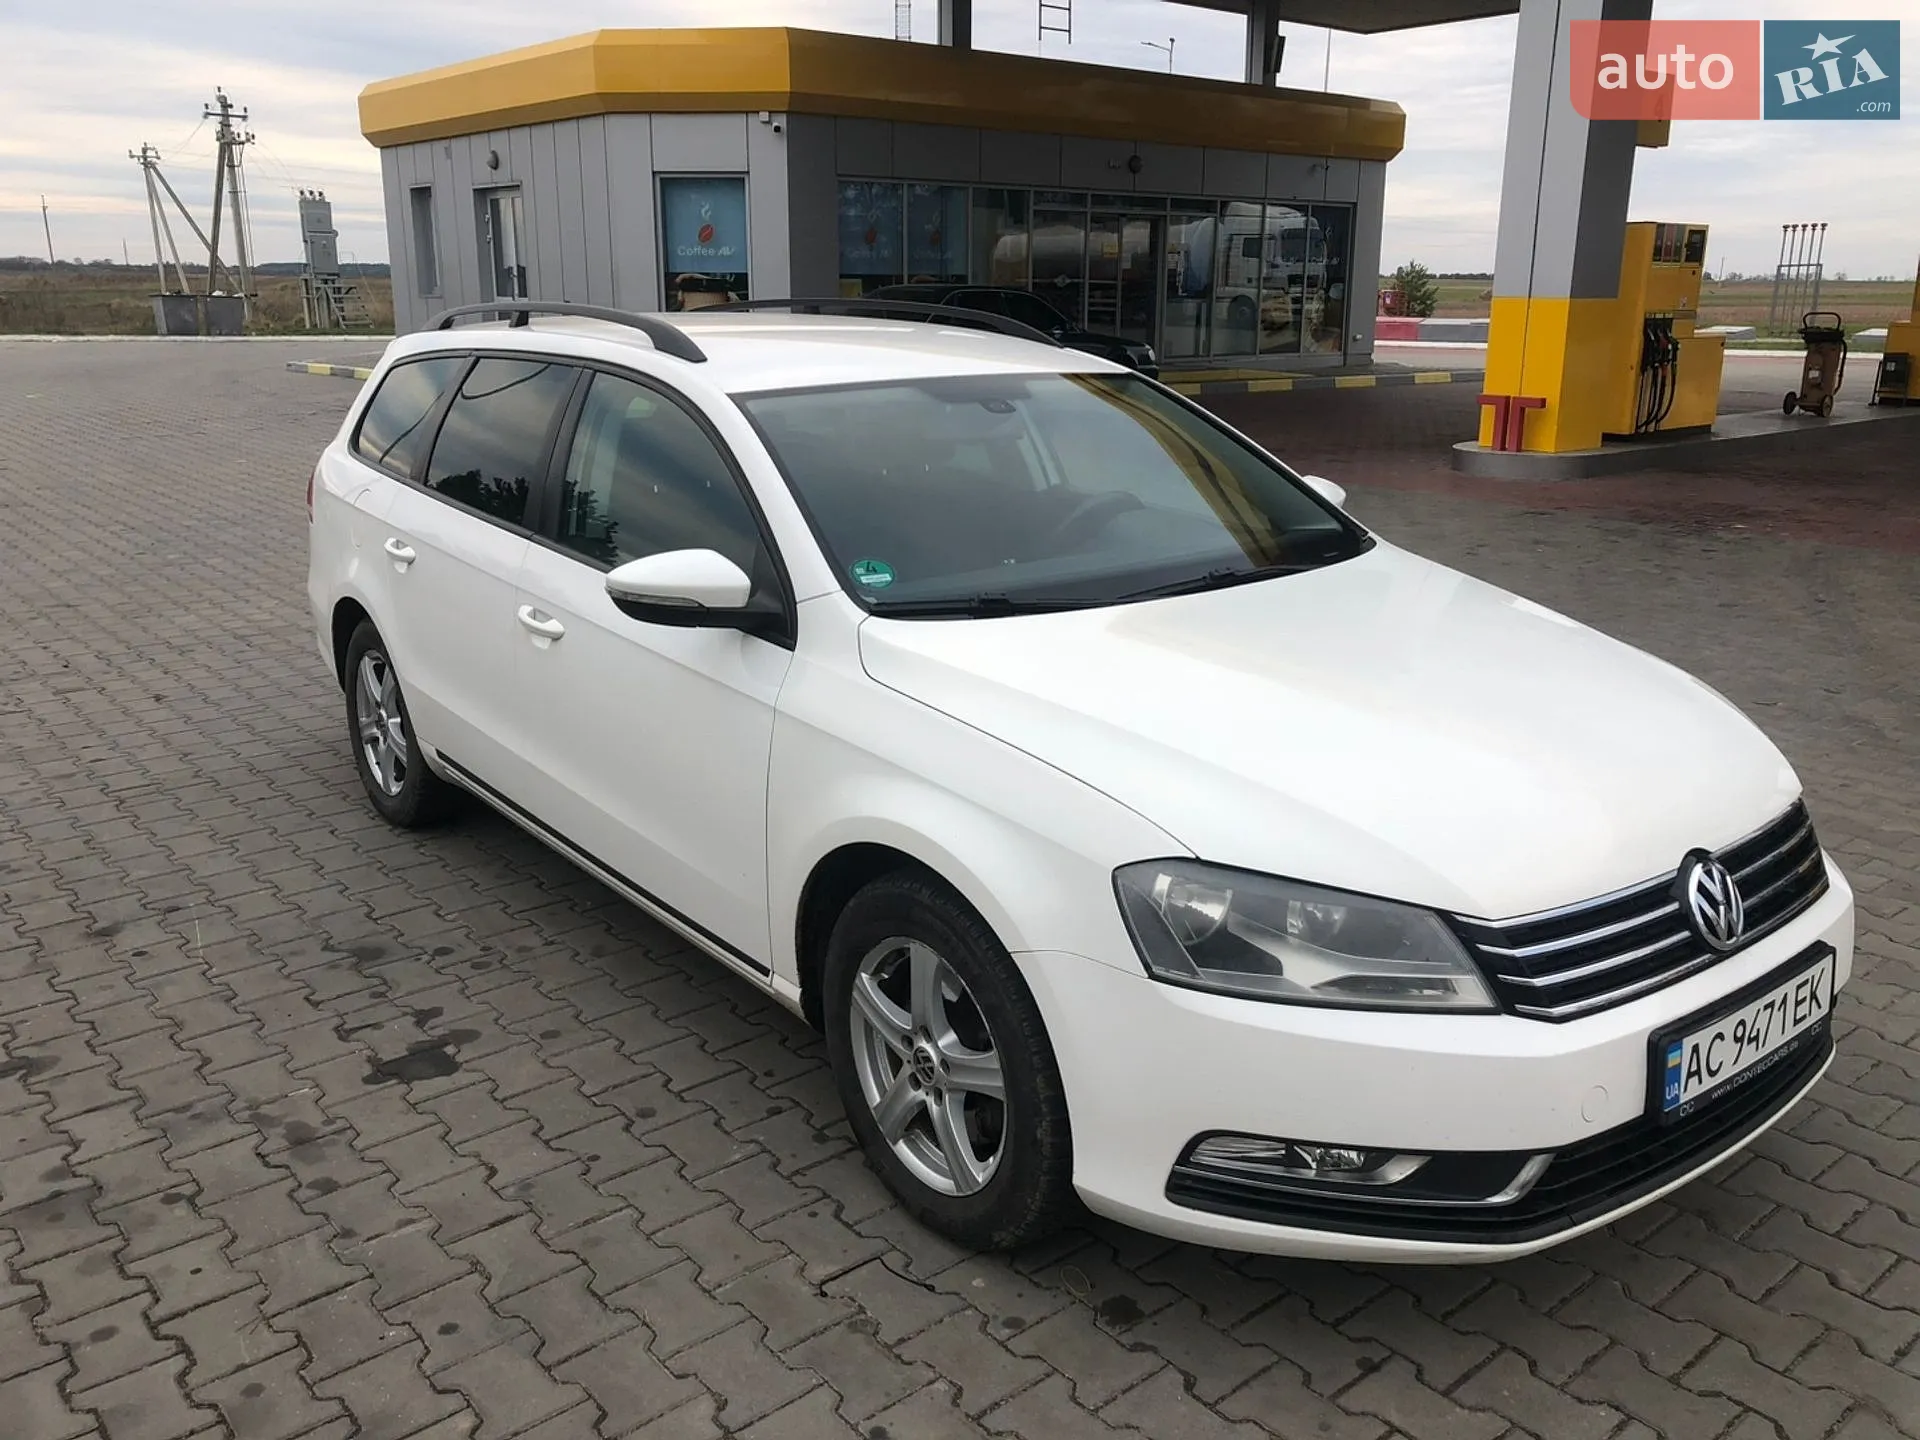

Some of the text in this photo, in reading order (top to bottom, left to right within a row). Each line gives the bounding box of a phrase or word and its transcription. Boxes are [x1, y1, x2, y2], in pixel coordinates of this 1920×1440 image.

[678, 246, 716, 256] Coffee
[1683, 967, 1825, 1093] AC 9471 EK
[1666, 1082, 1679, 1100] UA
